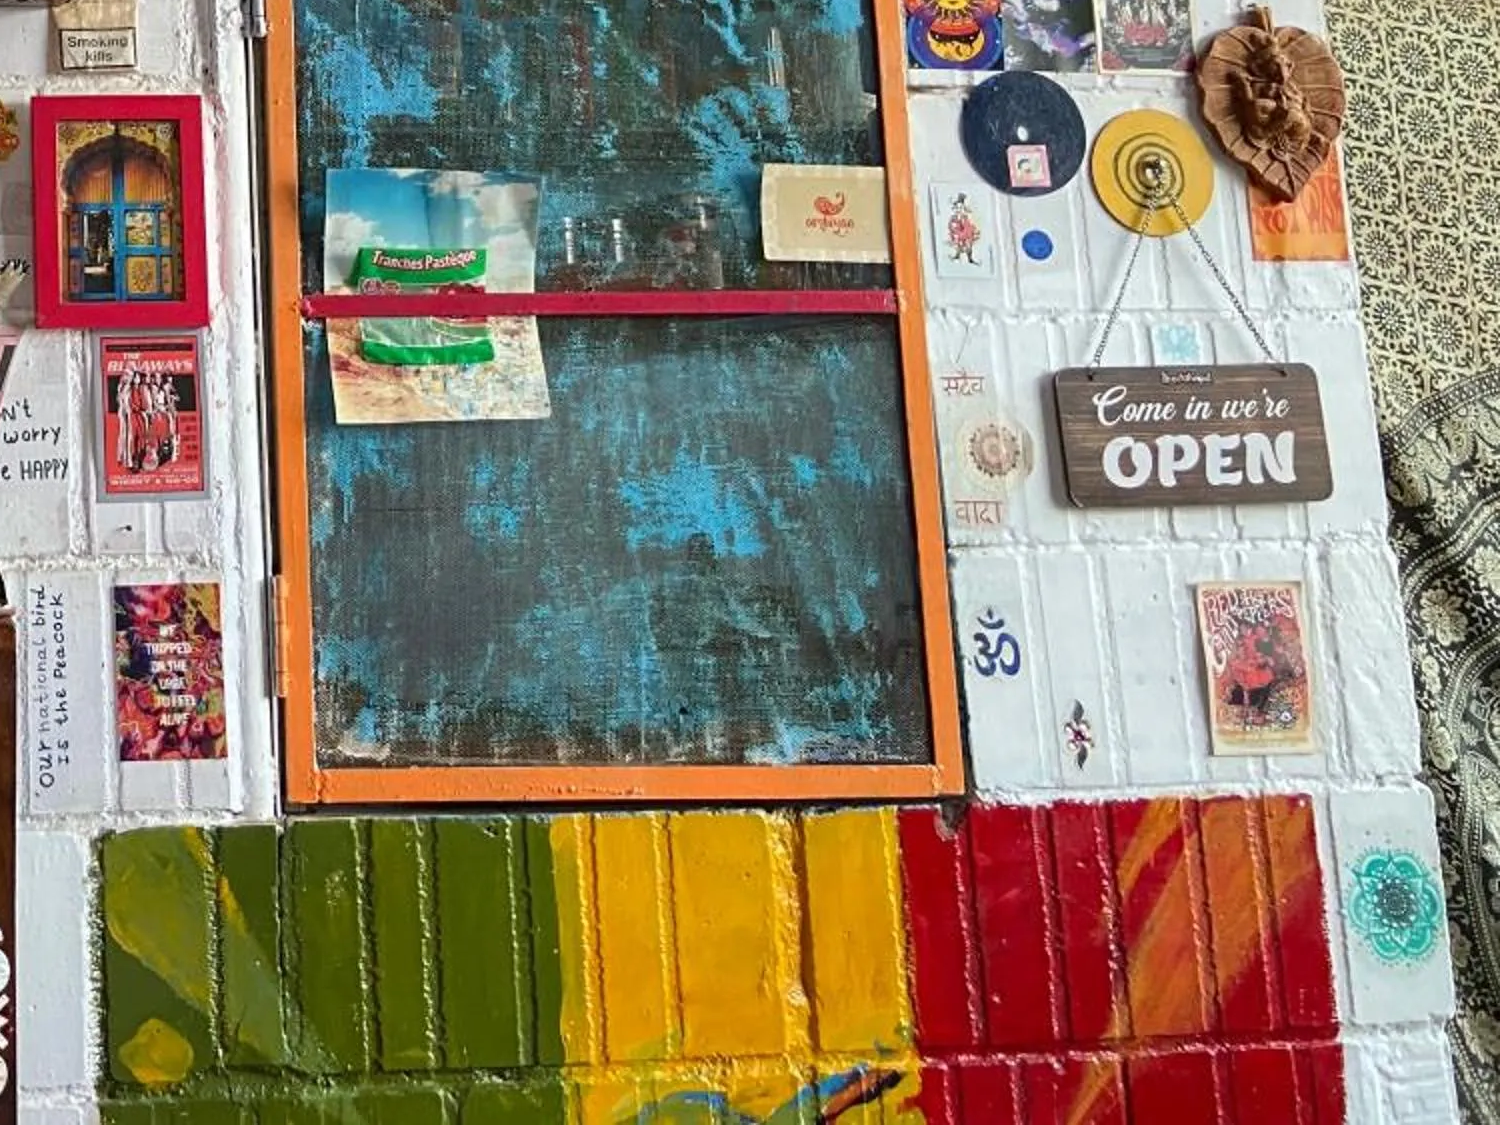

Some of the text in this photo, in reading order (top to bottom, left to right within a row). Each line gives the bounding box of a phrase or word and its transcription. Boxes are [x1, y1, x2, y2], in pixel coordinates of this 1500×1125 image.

[67, 35, 129, 48] Smoking
[85, 50, 113, 62] kills
[372, 249, 477, 270] Tranches Pastèque
[1092, 385, 1291, 427] Come in we're
[3, 426, 62, 446] worry
[20, 458, 69, 480] HAPPY
[1102, 430, 1297, 489] OPEN
[30, 584, 46, 626] bird
[146, 642, 192, 656] TRIPPED
[32, 637, 50, 734] national
[55, 688, 69, 726] the
[159, 713, 190, 726] ALIVE
